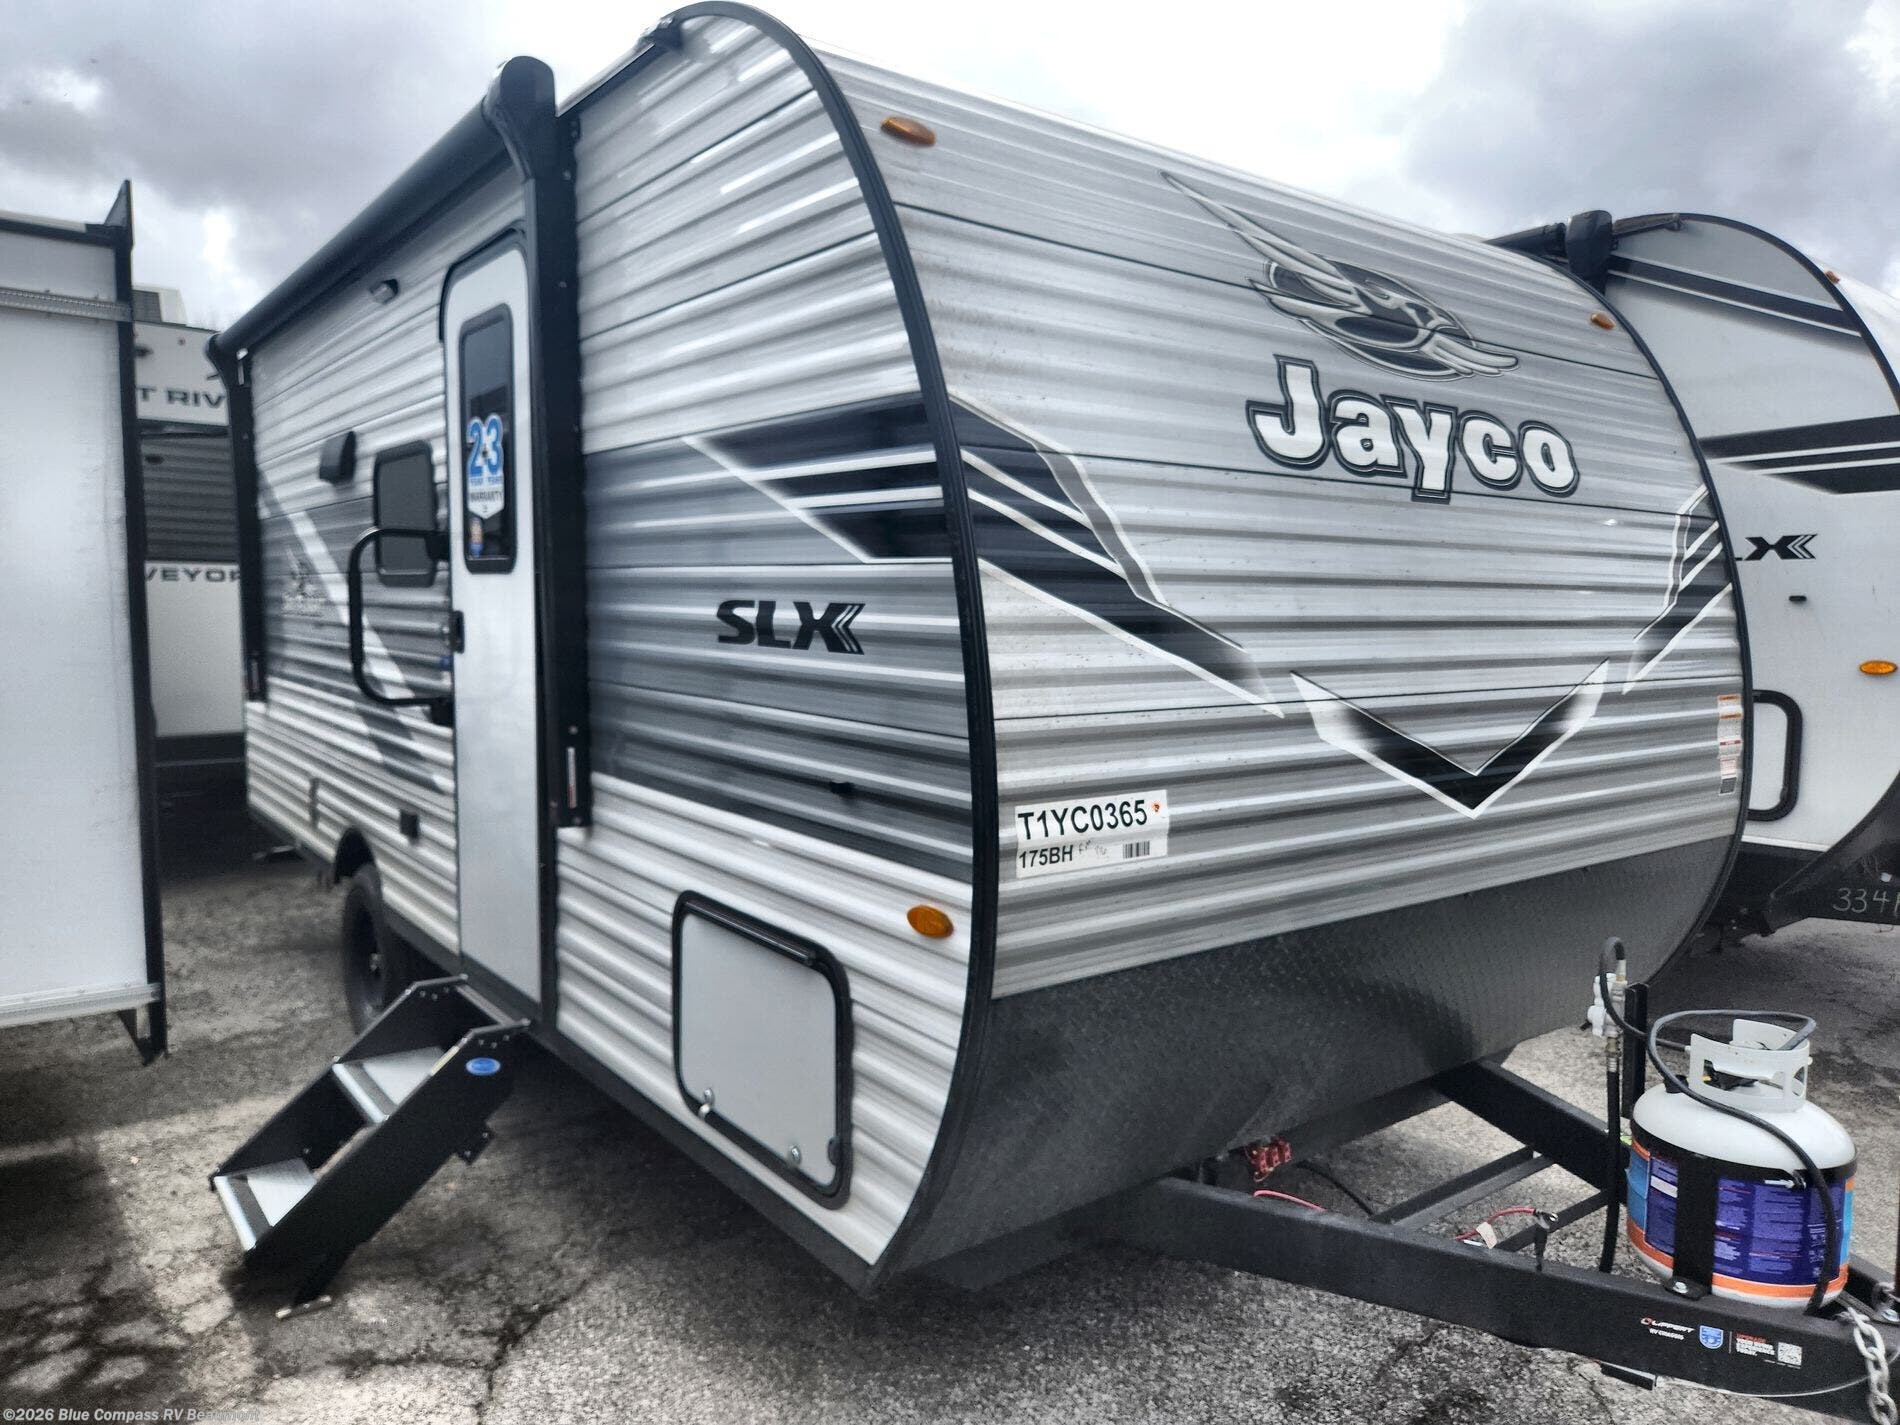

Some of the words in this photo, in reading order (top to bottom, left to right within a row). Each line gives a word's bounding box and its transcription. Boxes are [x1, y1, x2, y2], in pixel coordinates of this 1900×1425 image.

[1246, 354, 1580, 504] Jayco
[717, 600, 865, 655] SLX
[1018, 800, 1148, 839] T1YC0365
[1019, 844, 1073, 868] 175BH
